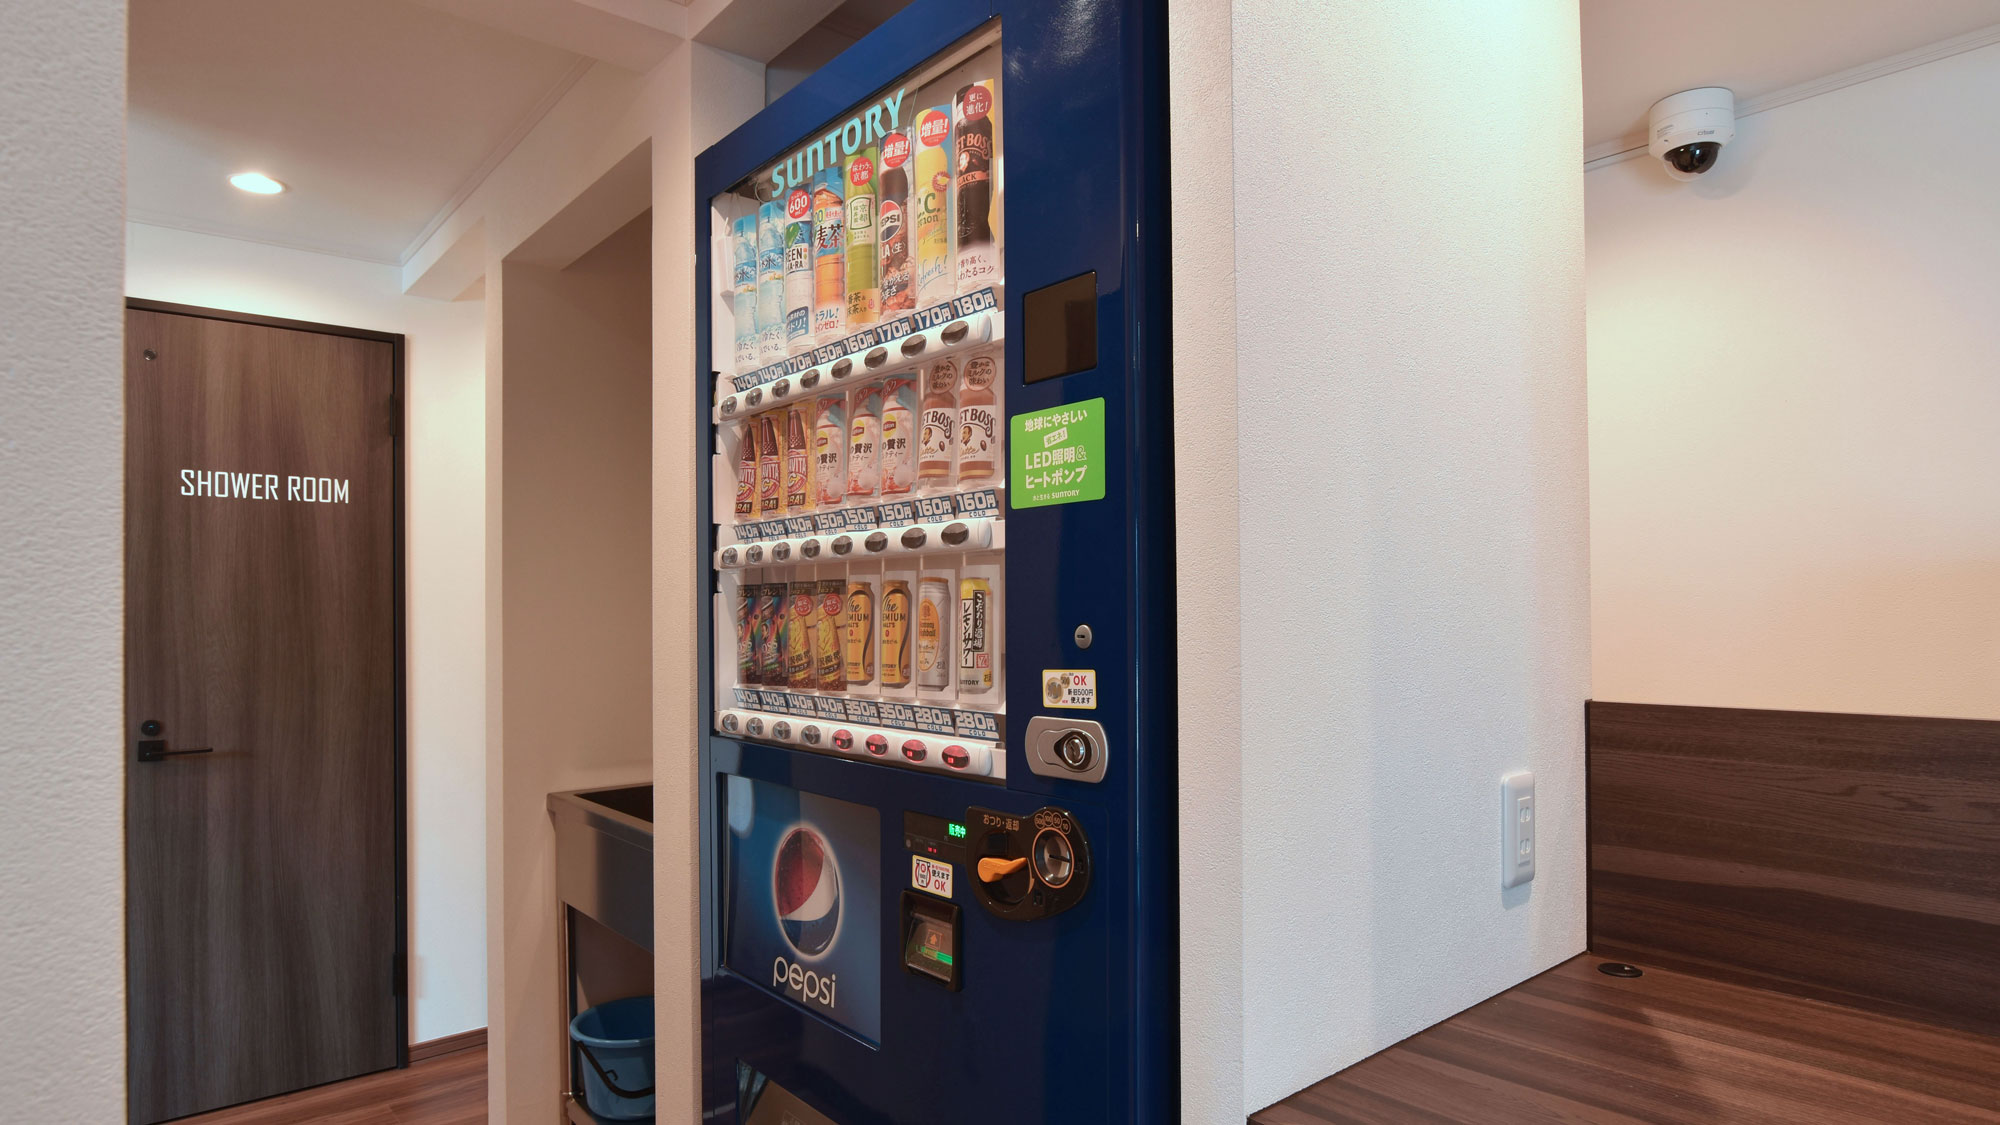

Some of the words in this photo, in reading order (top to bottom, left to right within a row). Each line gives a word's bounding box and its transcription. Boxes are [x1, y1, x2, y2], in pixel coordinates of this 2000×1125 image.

[969, 92, 983, 103] 更に
[920, 118, 949, 138] 増量!
[771, 88, 905, 198] SUNTORY
[884, 140, 910, 160] 増量!
[966, 132, 992, 160] BOSS
[789, 194, 808, 215] 600
[817, 223, 844, 249] 麦茶
[954, 291, 995, 317] 180円
[914, 305, 952, 330] 170円
[877, 319, 911, 342] 170円
[843, 333, 876, 354] 160円
[785, 353, 813, 374] 170円
[814, 343, 844, 365] 150円
[759, 364, 784, 381] 140円
[734, 376, 758, 392] 140円
[931, 410, 956, 440] BOSS
[969, 408, 997, 439] BOSS
[1025, 409, 1088, 432] 地球にやさしい
[1025, 445, 1087, 470] LED照明&
[181, 469, 279, 501] SHOWER
[287, 475, 349, 504] ROOM
[1025, 465, 1088, 489] ヒートポンプ
[956, 491, 996, 512] 160円
[1051, 489, 1080, 500] SUNTORY
[842, 507, 876, 525] 150円
[878, 502, 913, 521] 150円
[915, 497, 952, 517] 160円
[785, 518, 813, 534] 140円
[815, 512, 845, 530] 150円
[890, 520, 905, 528] COLD
[927, 515, 943, 523] COLD
[735, 525, 759, 540] 140円
[760, 522, 785, 537] 140円
[962, 602, 973, 666] レモンサワー
[1073, 675, 1087, 686] OK
[734, 689, 759, 704] 140円
[760, 692, 786, 707] 140円
[787, 694, 814, 710] 140円
[815, 697, 845, 714] 140円
[846, 700, 878, 717] 350円
[878, 703, 914, 721] 350円
[913, 706, 952, 726] 280円
[891, 719, 906, 727] COLD
[927, 724, 943, 732] COLD
[954, 711, 996, 731] 280円
[968, 729, 986, 737] COLD
[983, 814, 1020, 832] おつり・返却
[932, 869, 950, 881] 使えます
[934, 879, 946, 892] OK
[773, 956, 836, 1008] pepsi
